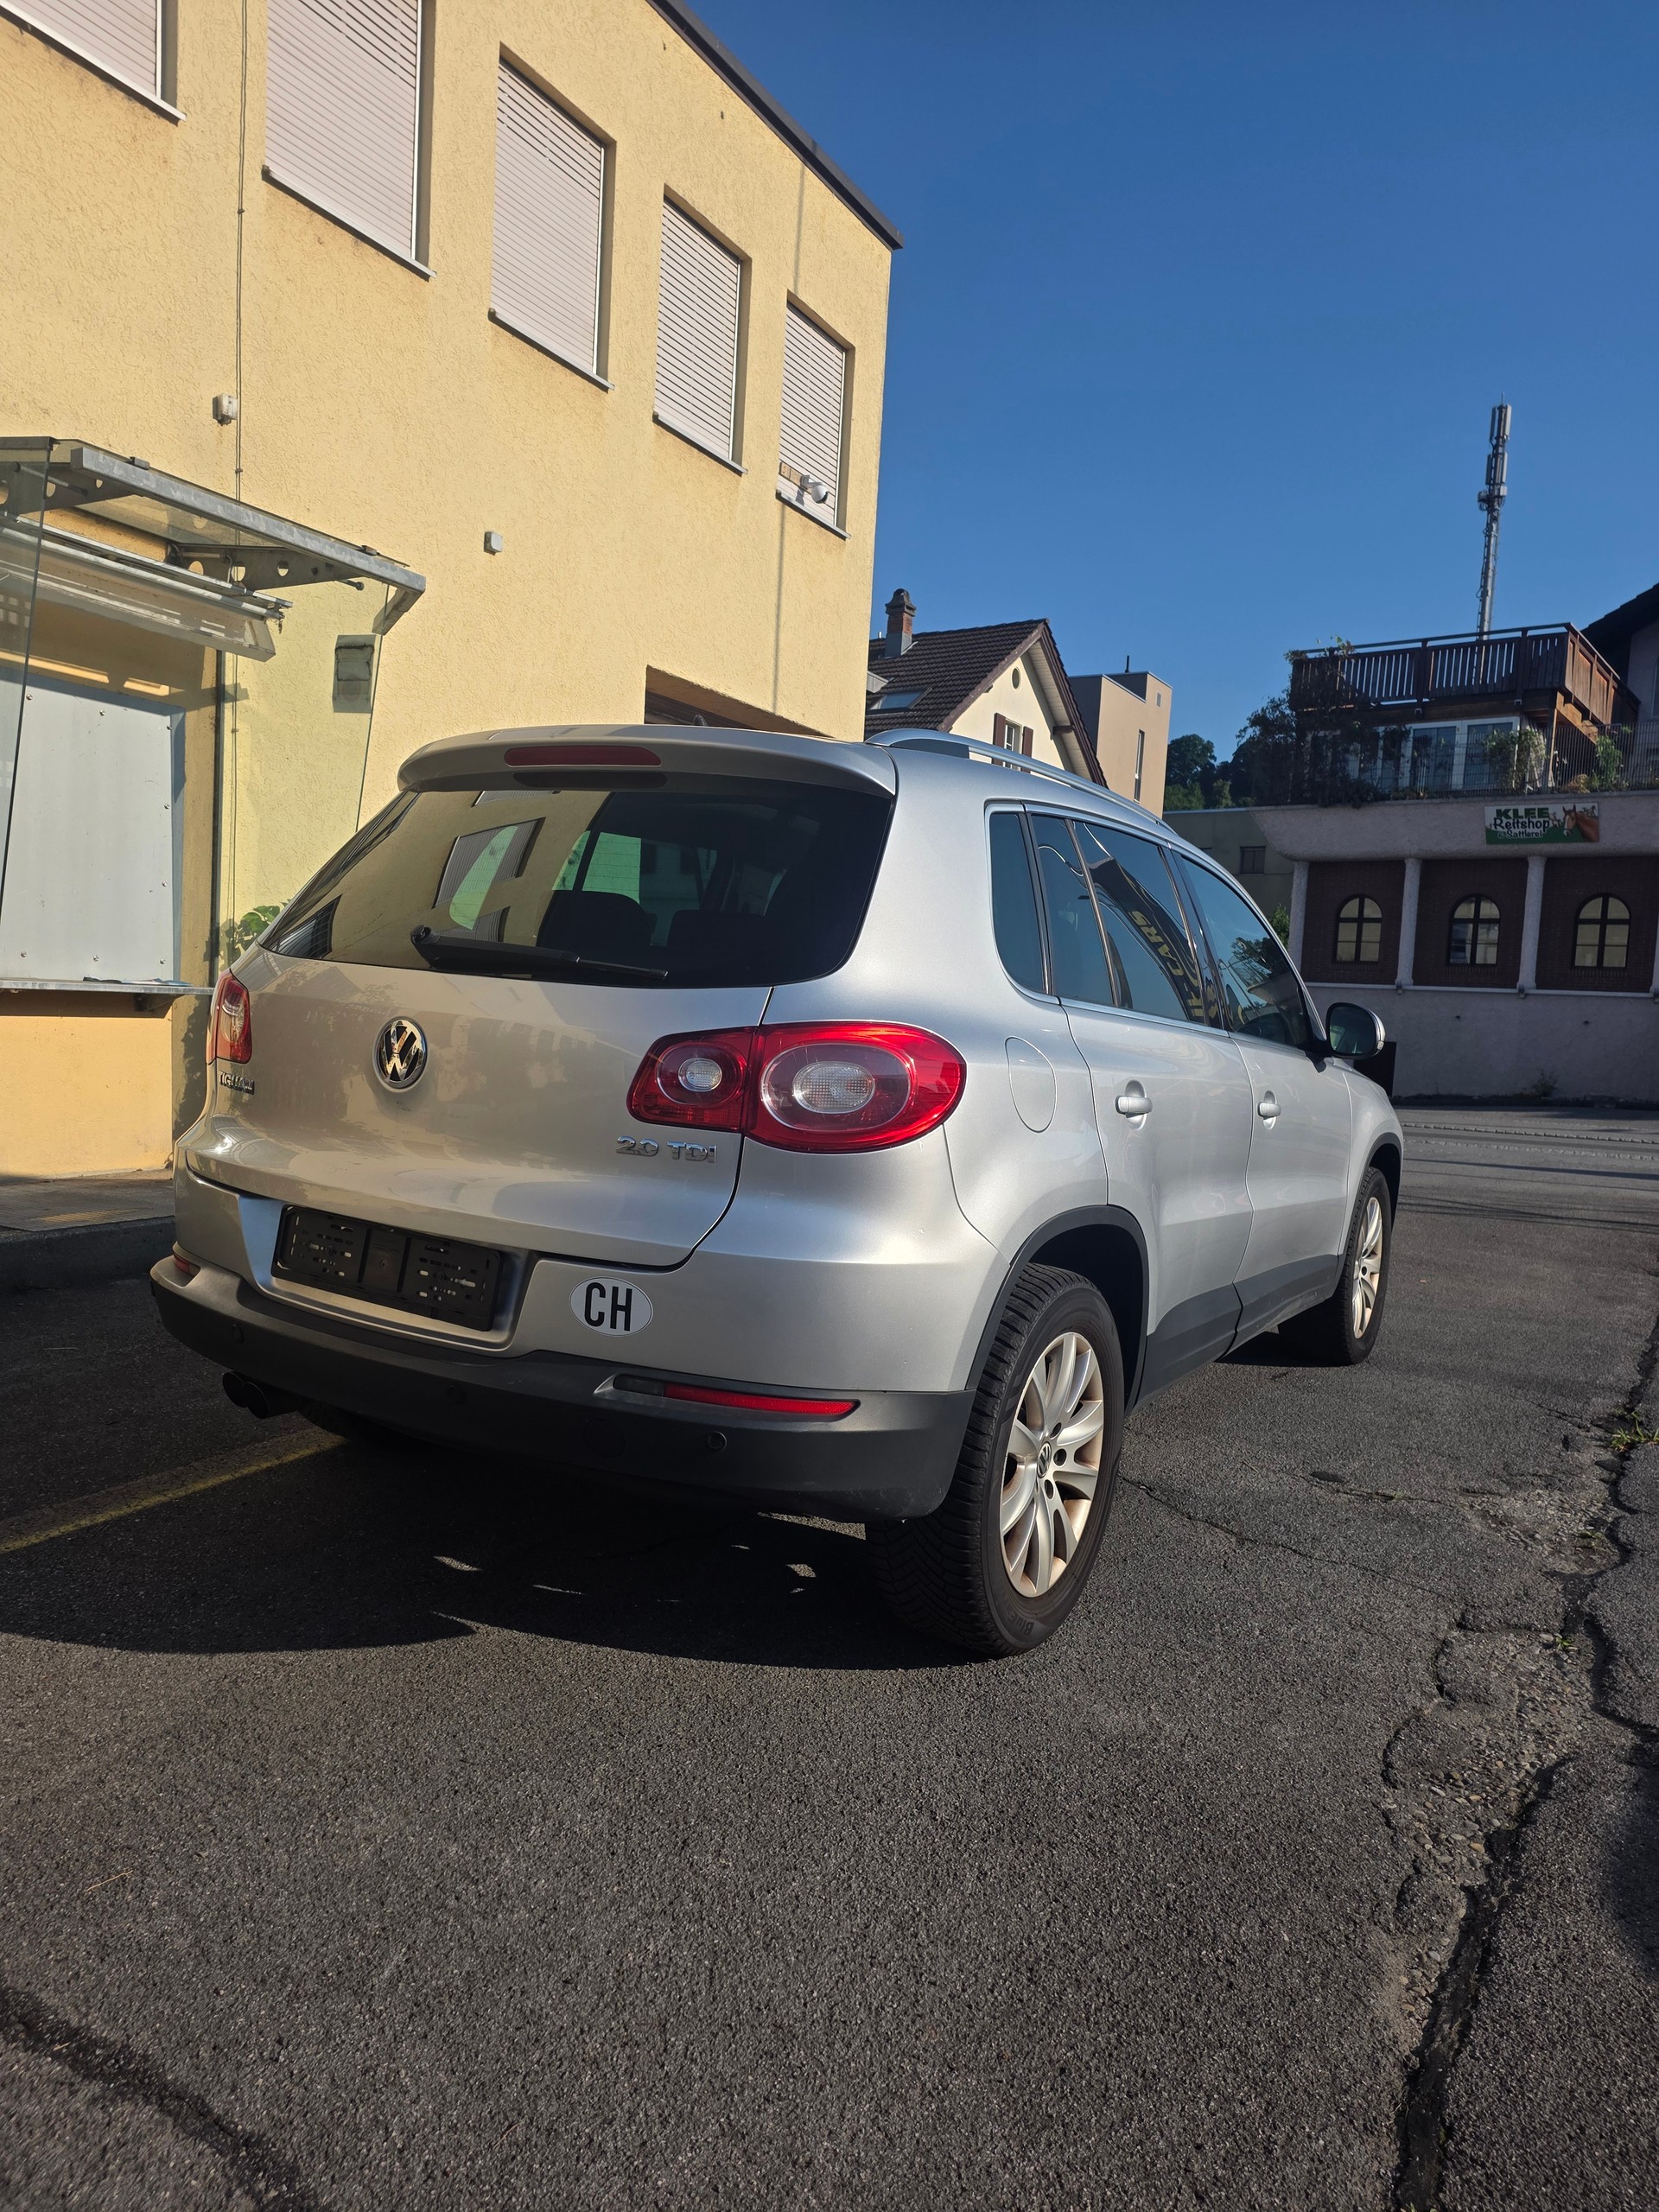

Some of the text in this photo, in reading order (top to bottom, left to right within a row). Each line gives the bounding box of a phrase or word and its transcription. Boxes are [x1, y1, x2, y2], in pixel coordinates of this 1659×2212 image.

[1493, 817, 1550, 833] Reitshop
[1496, 808, 1549, 820] KLEE
[378, 1020, 425, 1087] VW
[616, 1135, 717, 1163] 2.0 TDI
[584, 1281, 632, 1332] CH
